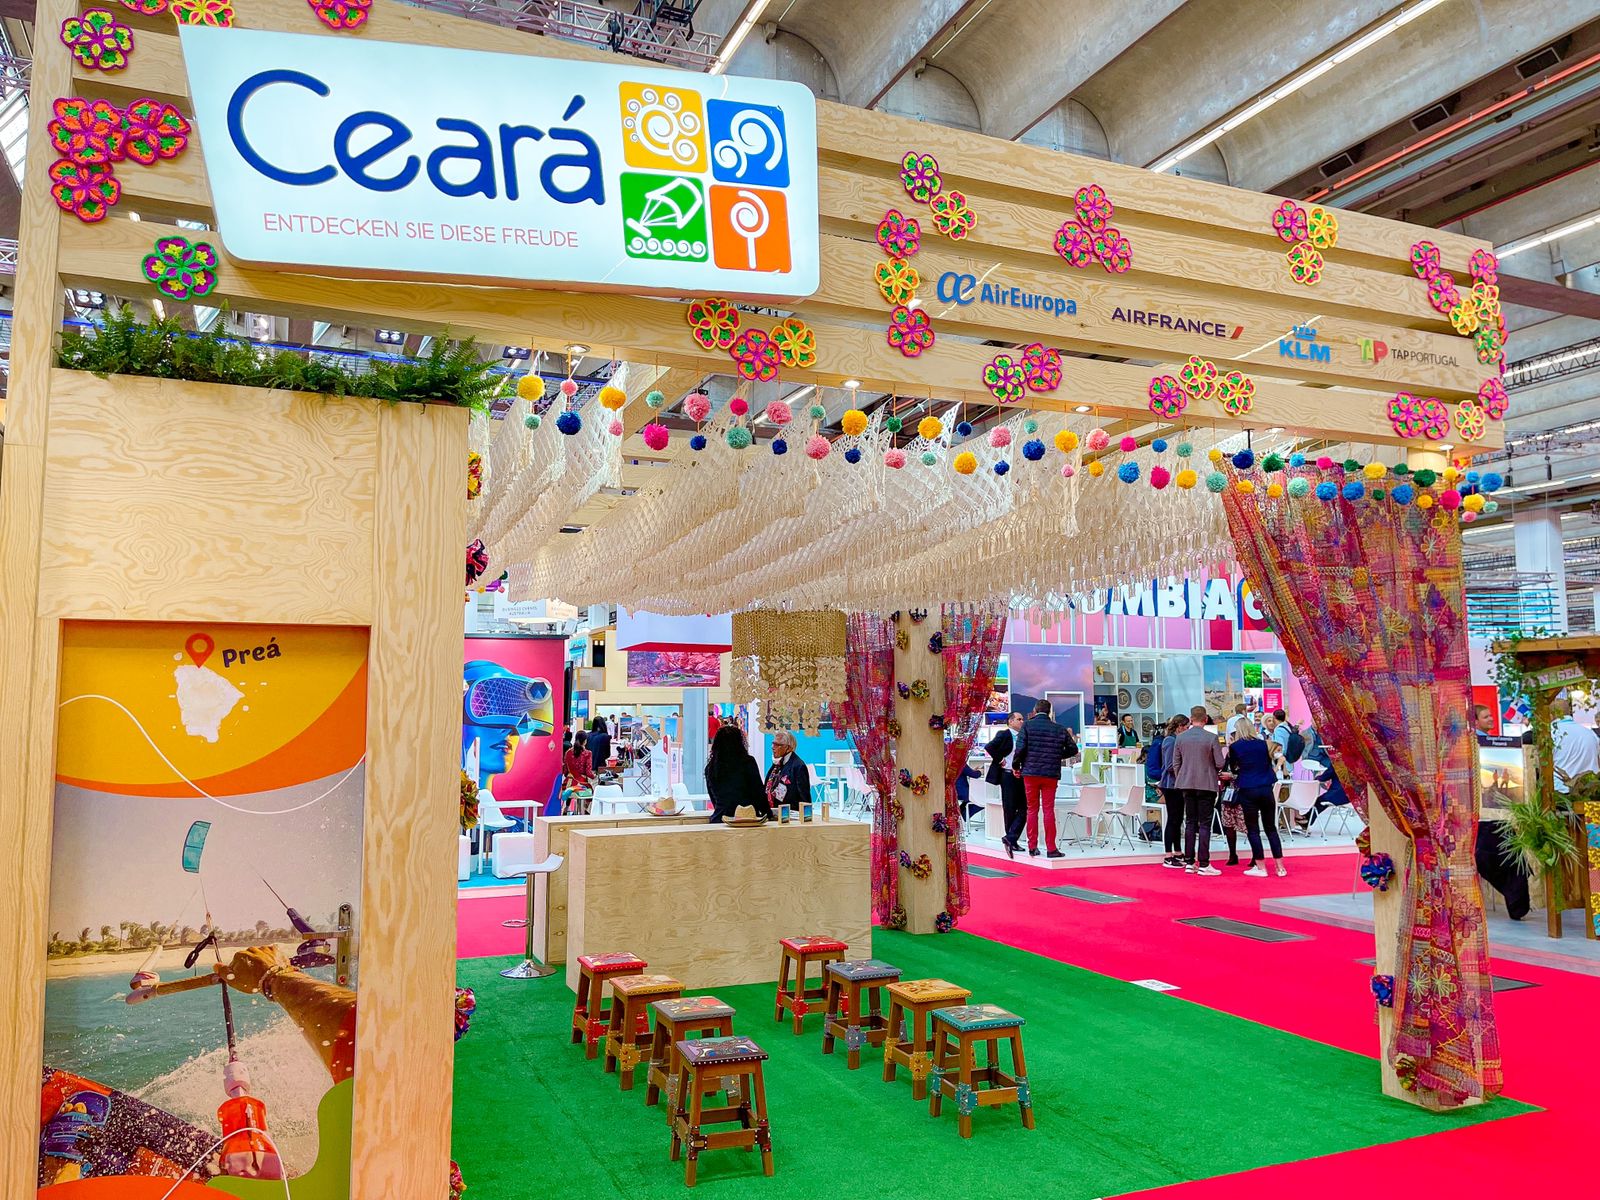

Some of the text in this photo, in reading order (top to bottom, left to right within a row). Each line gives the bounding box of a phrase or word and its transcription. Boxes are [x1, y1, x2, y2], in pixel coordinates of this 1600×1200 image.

[227, 69, 606, 206] Ceará
[264, 213, 579, 248] ENTDECKEN SIE DIESE FREUDE
[1279, 339, 1331, 363] KLM
[1391, 348, 1410, 361] TAP
[1410, 351, 1460, 367] PORTUGAL
